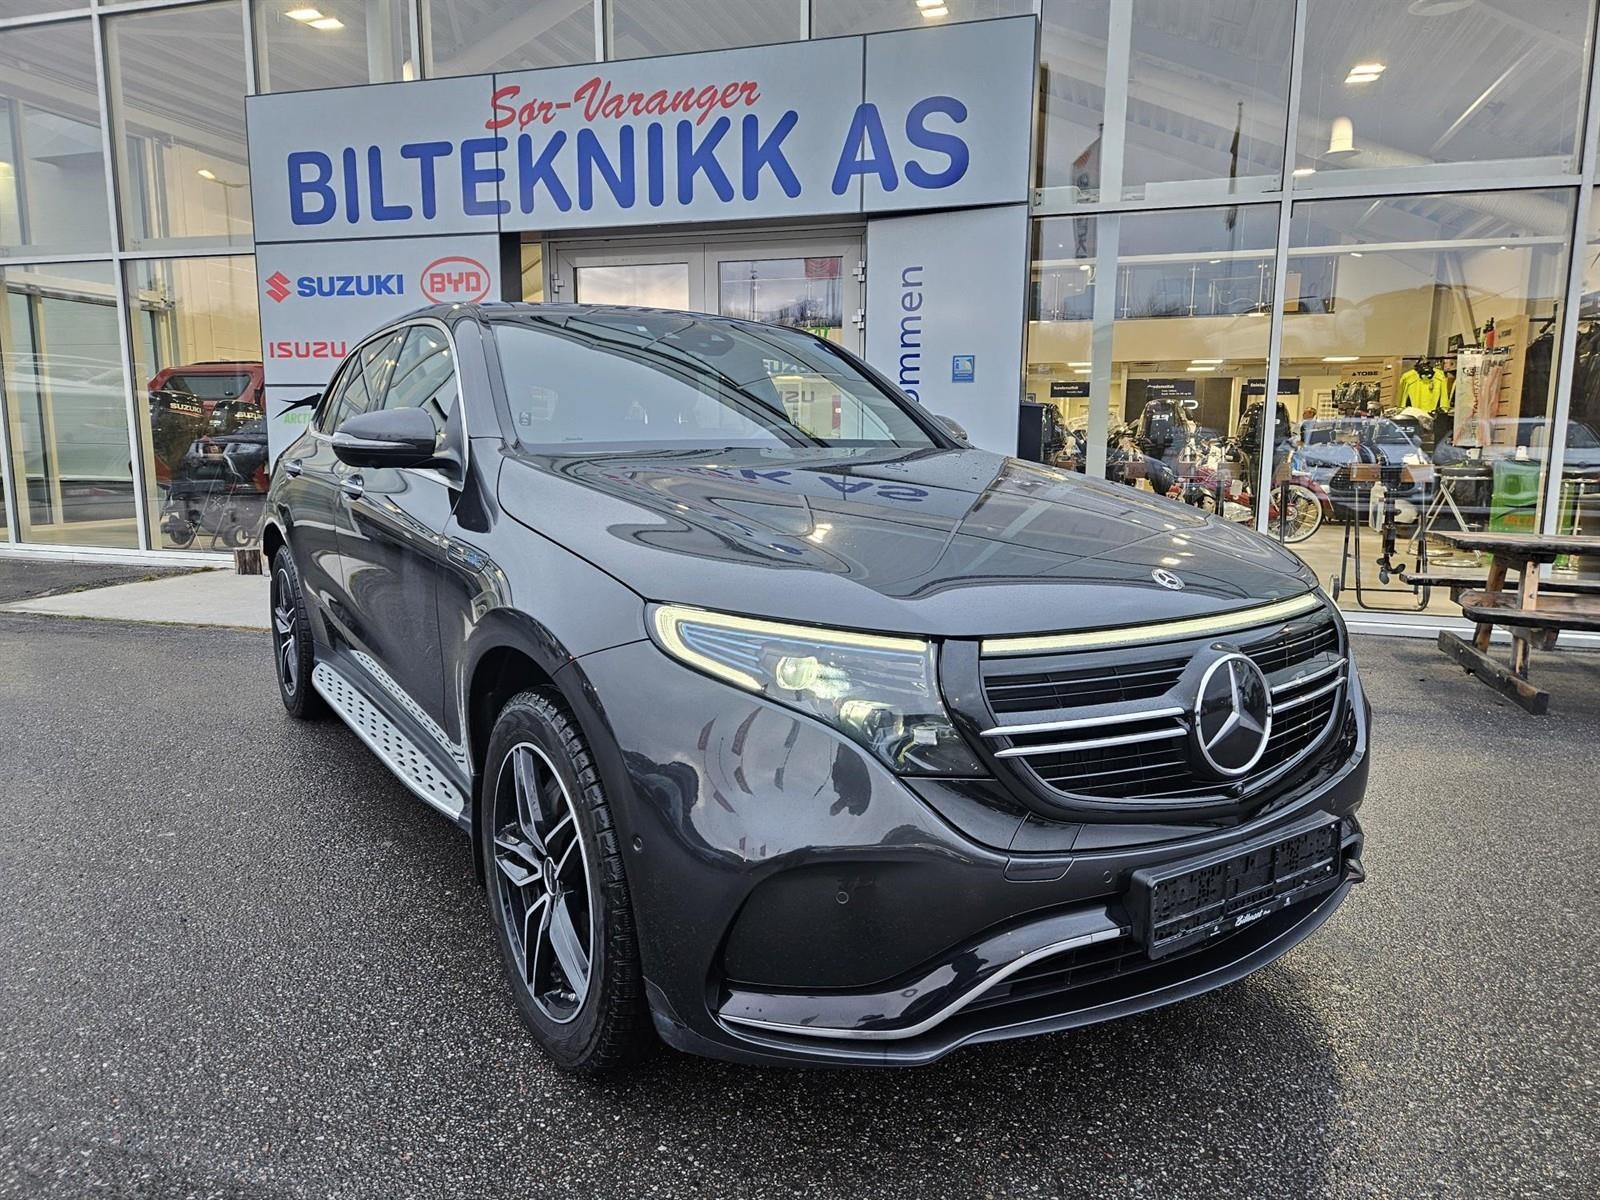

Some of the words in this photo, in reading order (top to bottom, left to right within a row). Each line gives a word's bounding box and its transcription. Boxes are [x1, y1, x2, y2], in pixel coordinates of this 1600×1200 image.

[485, 77, 761, 131] Sør-Varanger
[287, 110, 802, 225] BILTEKNIKK
[831, 95, 970, 196] AS
[296, 273, 404, 298] SUZUKI
[429, 271, 482, 293] BYD
[269, 341, 347, 358] ISUZU
[169, 402, 202, 414] SUZUKI
